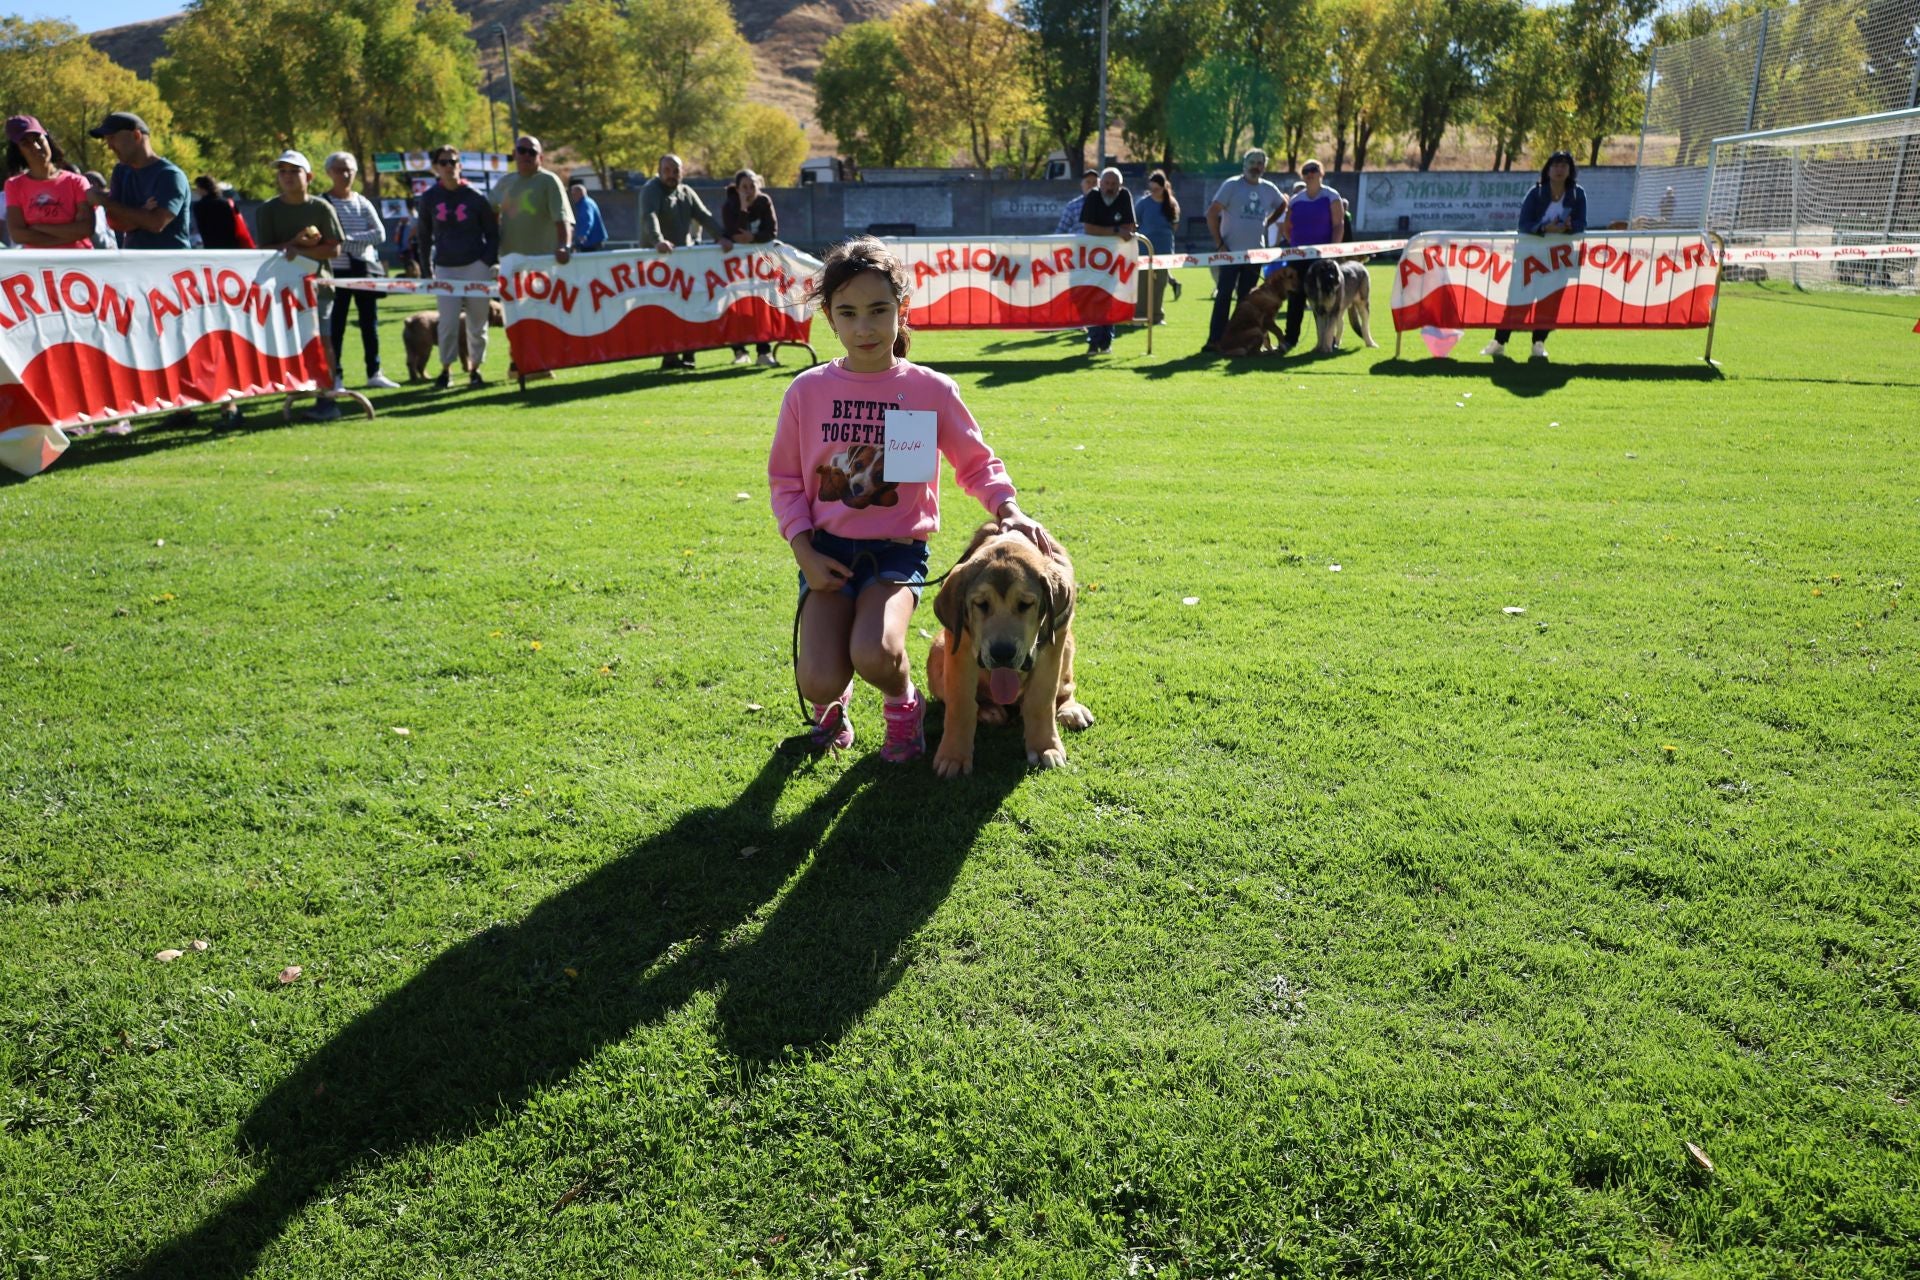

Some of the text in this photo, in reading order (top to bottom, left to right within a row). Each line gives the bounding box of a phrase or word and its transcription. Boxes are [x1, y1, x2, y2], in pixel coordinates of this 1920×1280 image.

[914, 246, 1136, 289] ARION ARION
[1400, 243, 1512, 288] ARION
[1523, 242, 1644, 287] ARION
[1744, 249, 1777, 261] ARION
[1788, 248, 1822, 260] ARION
[1834, 247, 1868, 259] ARION
[1880, 245, 1915, 257] ARION
[147, 267, 272, 336] ARION
[589, 260, 695, 313] ARION
[705, 254, 796, 301] ARION
[821, 422, 885, 445] TOGETH
